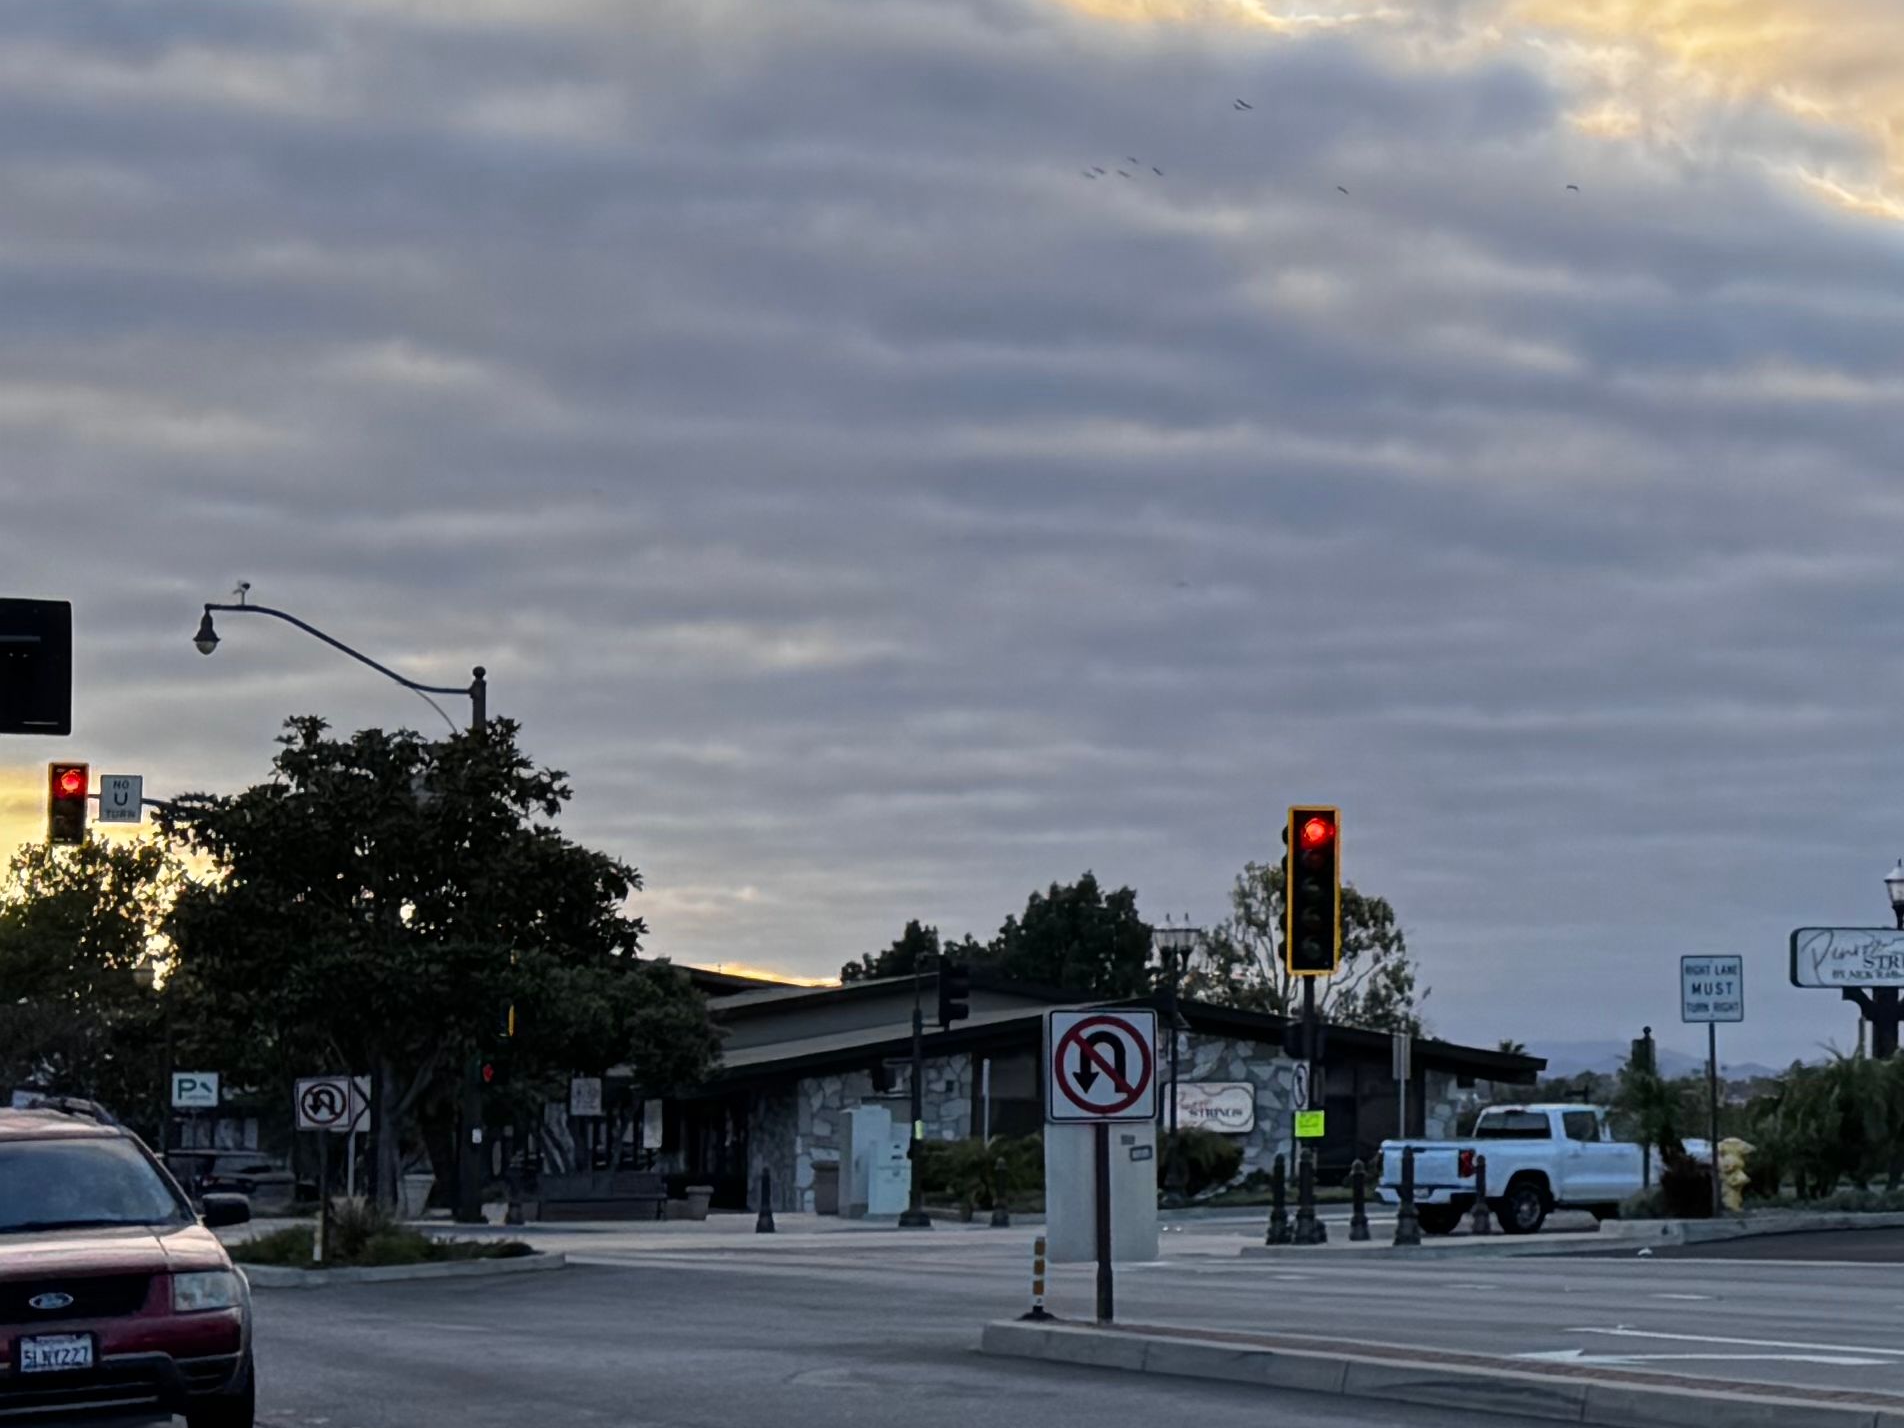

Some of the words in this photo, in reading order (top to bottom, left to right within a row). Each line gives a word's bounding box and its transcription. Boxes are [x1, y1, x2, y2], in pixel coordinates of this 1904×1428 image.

[113, 779, 129, 789] NO
[114, 792, 128, 806] U
[1685, 965, 1710, 975] RIGHT
[1715, 965, 1737, 975] LANE
[1692, 982, 1732, 995] MUST
[1686, 1003, 1709, 1013] TURN
[1713, 1003, 1738, 1012] RIGHT
[178, 1078, 197, 1100] P
